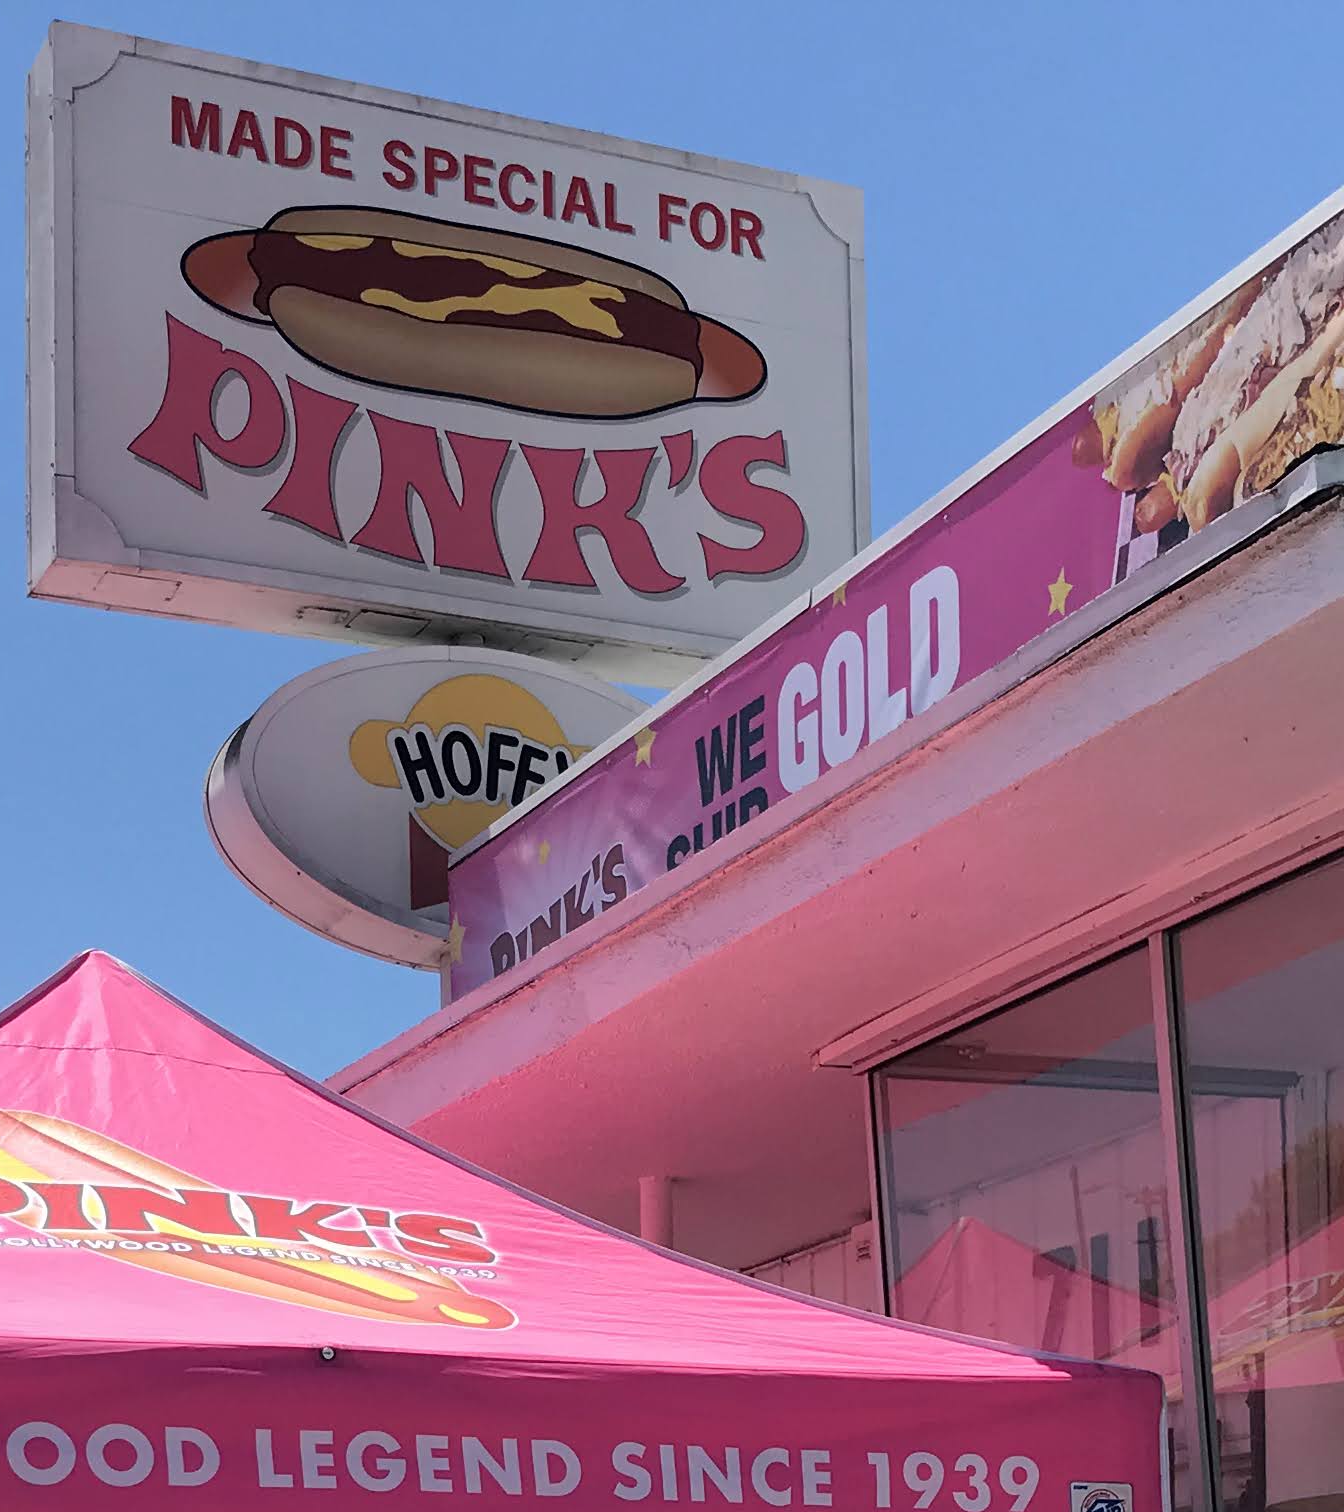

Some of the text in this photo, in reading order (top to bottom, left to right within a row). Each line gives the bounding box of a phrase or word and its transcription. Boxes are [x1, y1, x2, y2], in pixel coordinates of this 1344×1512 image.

[171, 96, 766, 260] MADE SPECIAL FOR
[127, 309, 806, 594] PINK'S
[777, 565, 960, 794] GOLD
[394, 731, 571, 806] HOFF
[695, 695, 766, 807] WE
[204, 1243, 320, 1262] LEGEND
[329, 1254, 417, 1273] SINCE
[426, 1265, 496, 1279] 1939
[256, 1428, 582, 1496] LEGEND
[613, 1442, 833, 1507] SINCE
